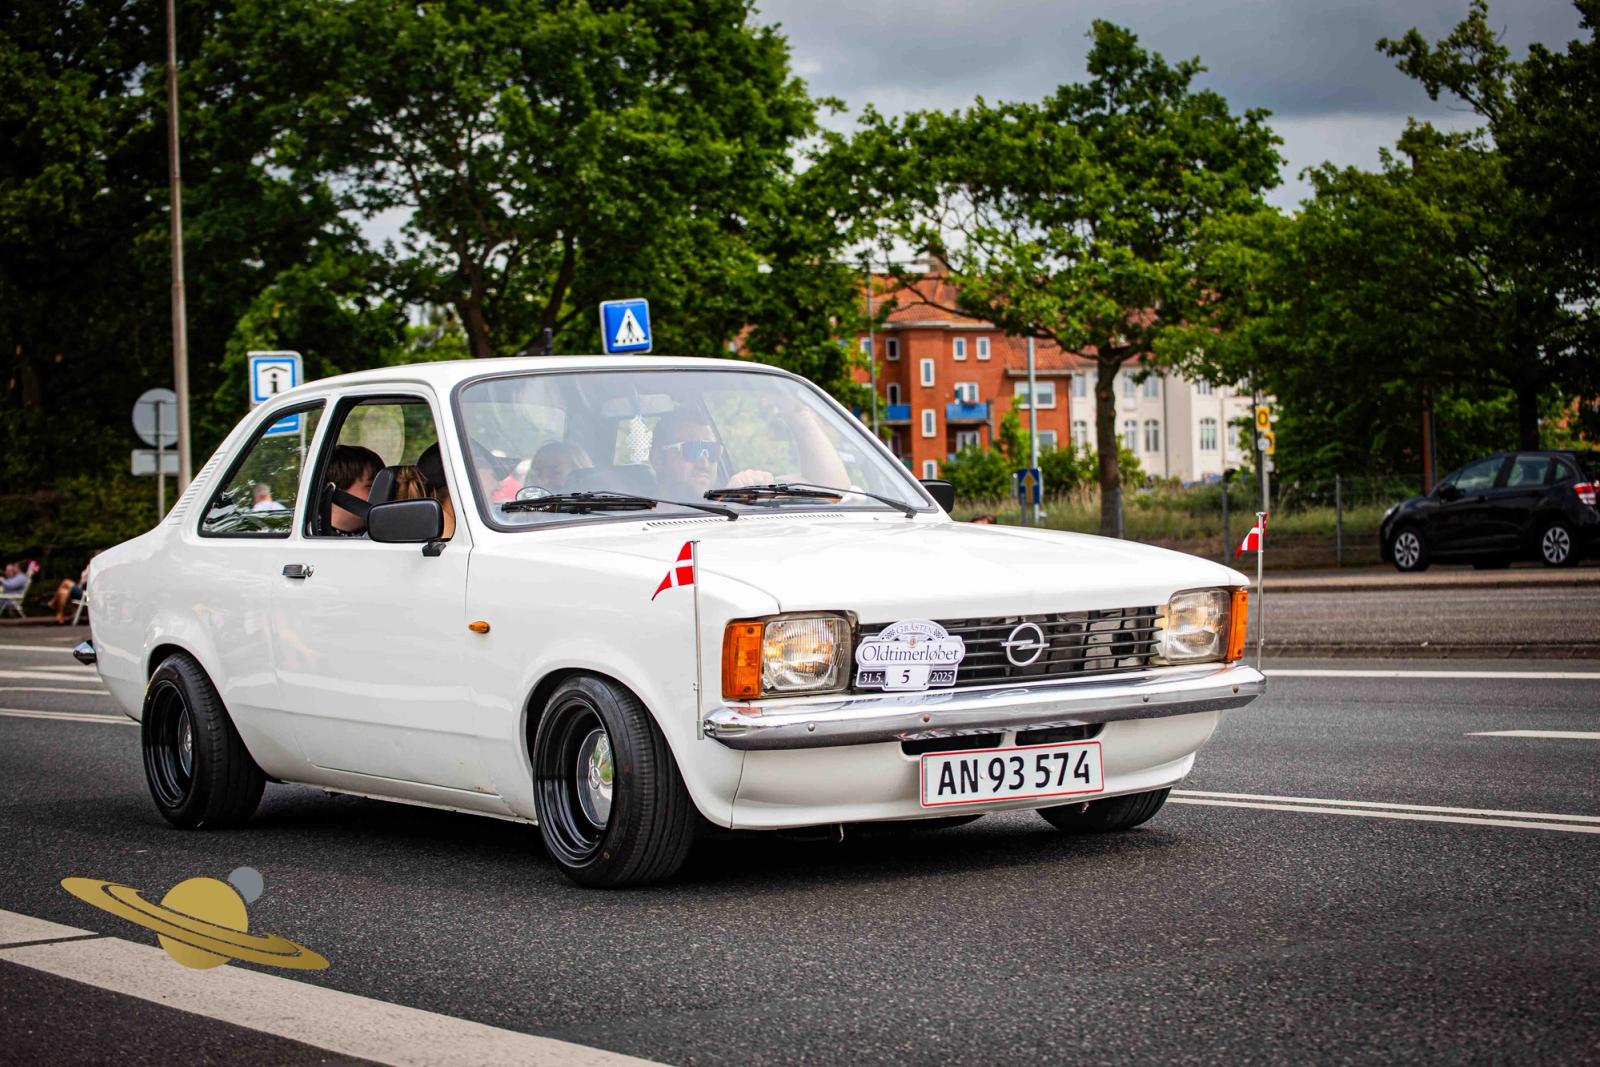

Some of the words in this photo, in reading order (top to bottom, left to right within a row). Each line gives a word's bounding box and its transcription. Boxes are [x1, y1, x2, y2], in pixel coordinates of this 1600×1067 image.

[862, 645, 959, 662] Oldtimerløbet
[862, 672, 883, 684] 31.5.
[901, 669, 910, 684] 5
[932, 671, 953, 682] 2025
[938, 759, 979, 795] AN
[988, 755, 1025, 793] 93
[1035, 750, 1090, 788] 574
